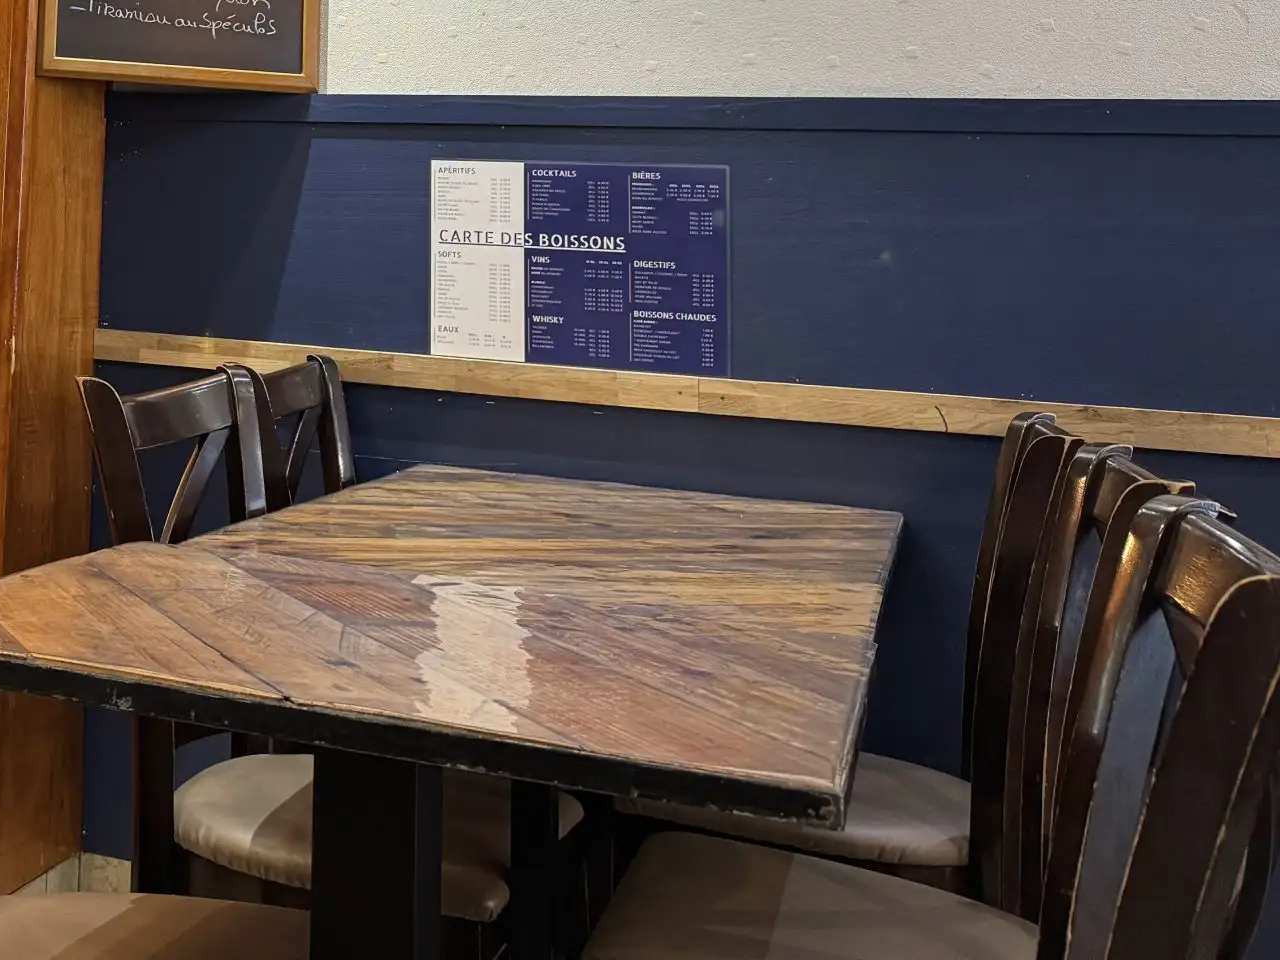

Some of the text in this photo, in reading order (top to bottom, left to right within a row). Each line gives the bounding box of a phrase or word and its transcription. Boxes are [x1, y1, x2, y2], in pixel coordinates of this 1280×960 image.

[175, 17, 198, 28] au
[438, 166, 476, 175] APÉRITIFS
[532, 169, 577, 177] COCKTAILS
[632, 170, 661, 180] BIÈRES
[439, 229, 626, 251] CARTE DES BOISSONS
[437, 251, 462, 259] SOFTS
[531, 256, 550, 264] VINS
[633, 260, 676, 270] DIGESTIFS
[532, 314, 564, 324] WHISKY
[633, 310, 717, 322] BOISSONS CHAUDES
[438, 325, 459, 334] EAUX
